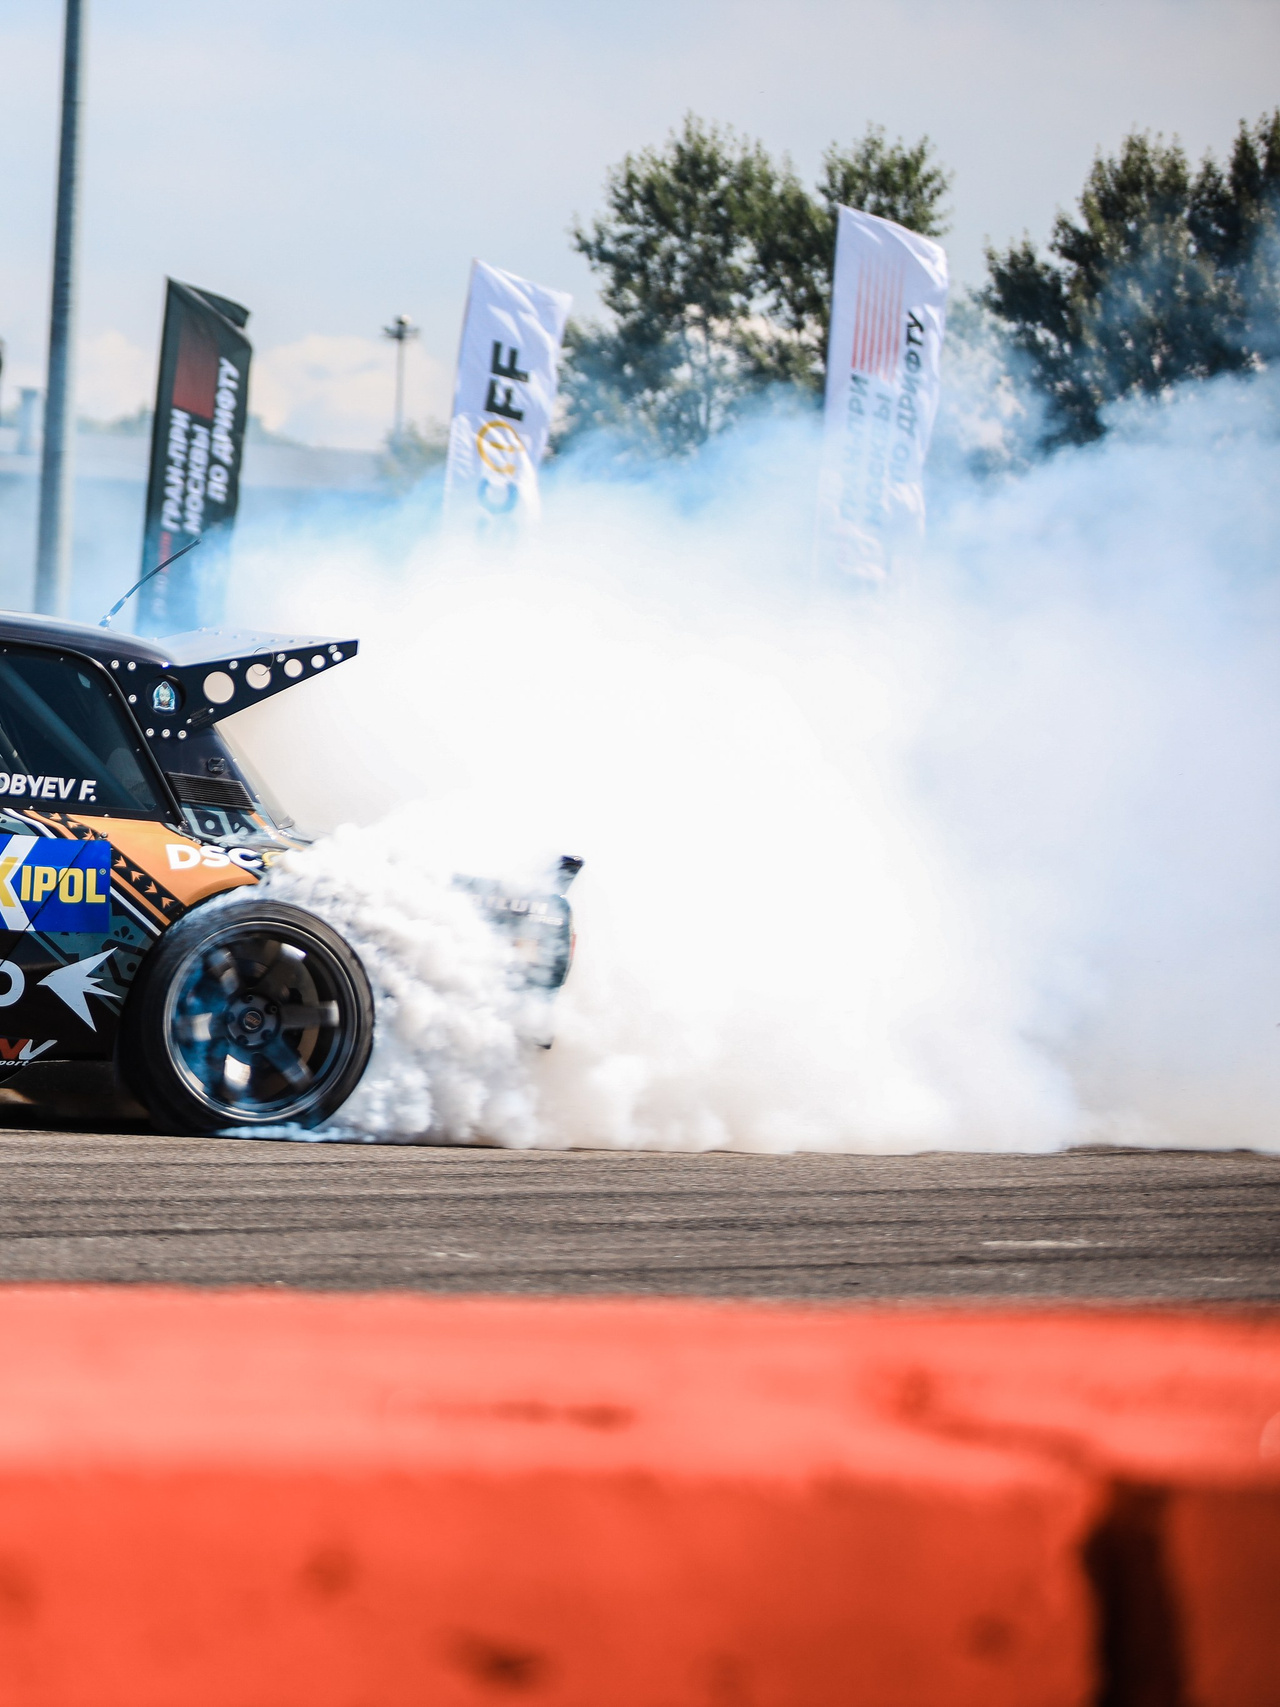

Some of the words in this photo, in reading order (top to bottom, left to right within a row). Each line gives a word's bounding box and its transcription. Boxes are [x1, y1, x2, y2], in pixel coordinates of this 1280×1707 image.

[211, 356, 241, 467] ДРИФТУ
[896, 309, 925, 440] ДРИФТУ
[161, 407, 192, 533] ГРАН-ПРИ
[182, 422, 211, 537] МОСКВЫ
[207, 465, 230, 503] ПО
[78, 778, 98, 802] F.
